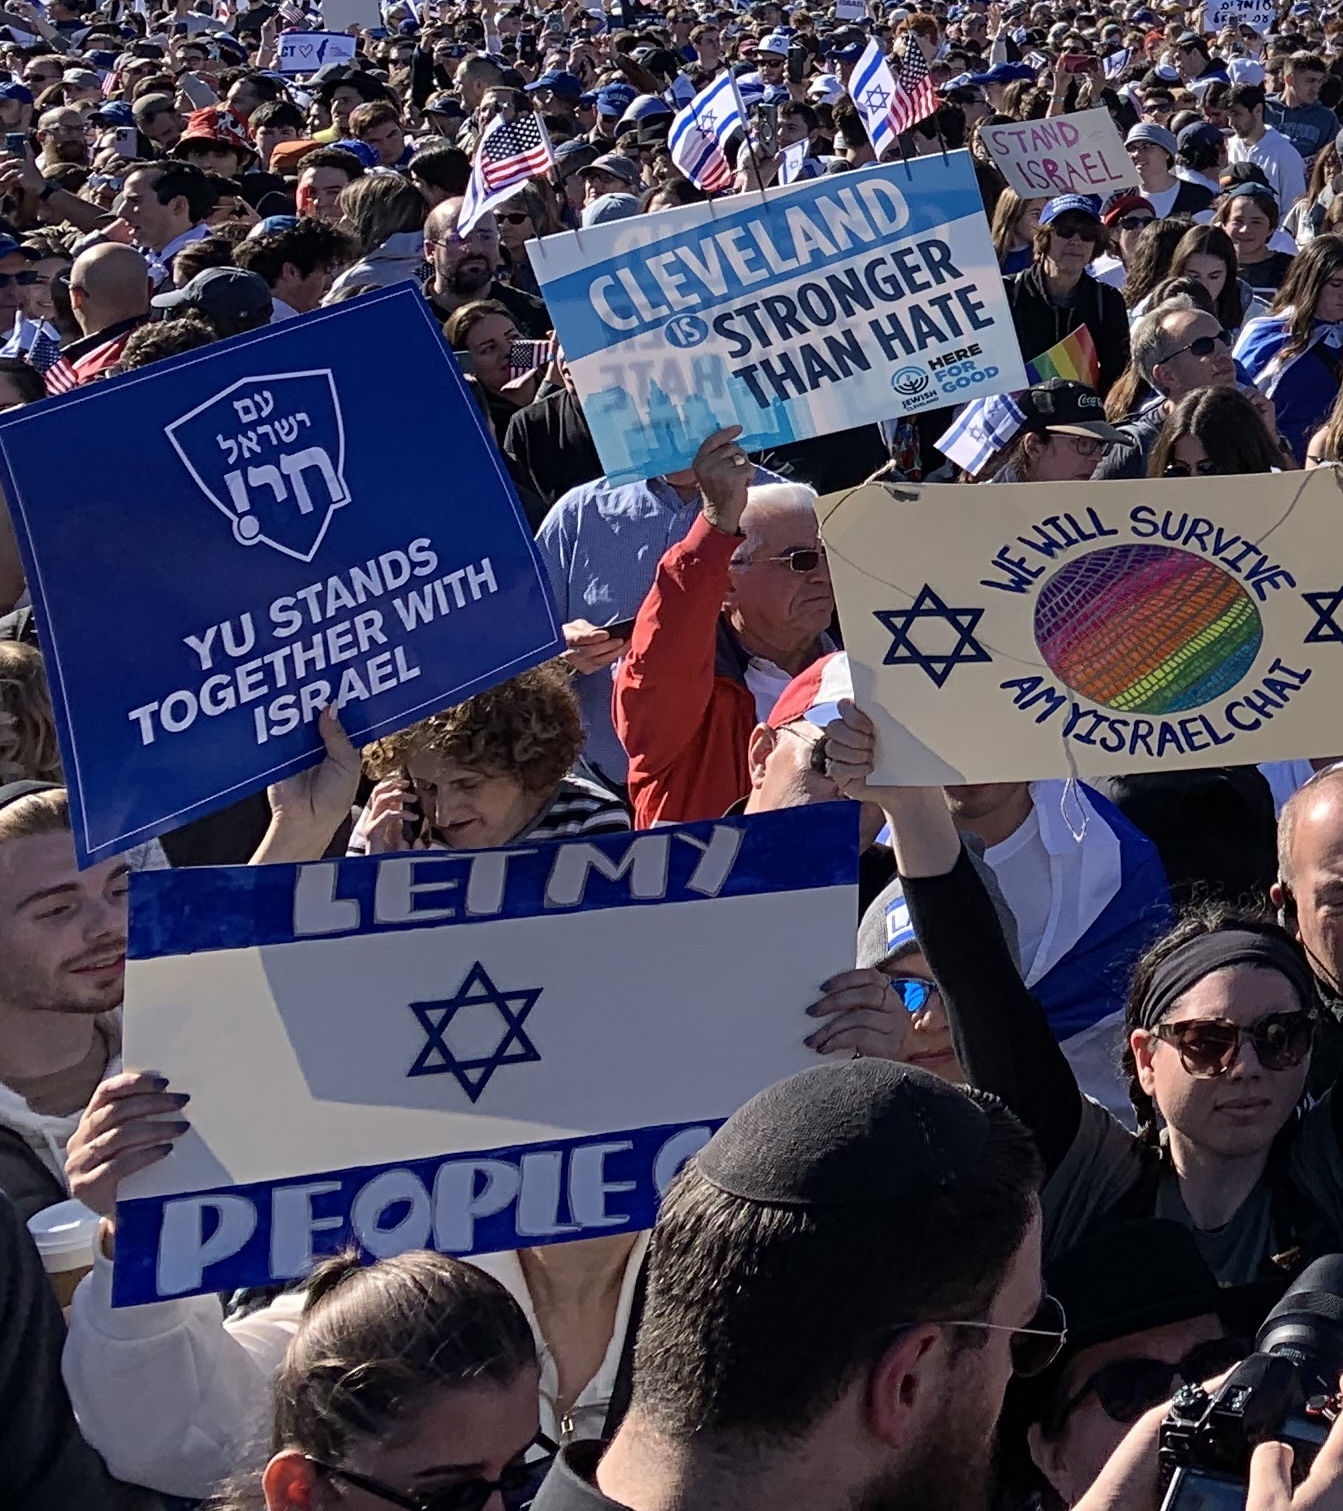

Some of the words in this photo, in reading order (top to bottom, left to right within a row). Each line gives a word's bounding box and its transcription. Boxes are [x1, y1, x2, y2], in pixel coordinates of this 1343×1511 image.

[281, 45, 298, 58] CT
[1212, 11, 1247, 24] ישאל
[991, 120, 1080, 156] STAND
[1015, 150, 1124, 192] ISRAEL
[587, 177, 912, 334] CLEVELAND
[712, 235, 967, 361] STRONGER
[731, 337, 873, 412] THAN
[871, 282, 998, 363] HATE
[927, 342, 984, 372] HERE
[934, 360, 977, 384] FOR
[941, 365, 1000, 395] GOOD
[232, 390, 275, 424] עם
[901, 389, 938, 409] JEWISH
[215, 412, 312, 465] ישראל
[979, 534, 1047, 599] WE
[1016, 504, 1119, 562] WILL
[1129, 503, 1298, 603] SURVIVE
[182, 615, 258, 673] YU
[267, 536, 441, 640] STANDS
[127, 612, 385, 748] TOGETHER
[397, 557, 500, 634] WITH
[253, 645, 423, 747] ISRAEL
[999, 673, 1067, 726] AM
[1066, 699, 1236, 759] YISRAEL
[1223, 656, 1315, 736] CHAI
[291, 848, 541, 939] LET
[543, 823, 749, 910] MY
[155, 1138, 638, 1298] PEOPLE
